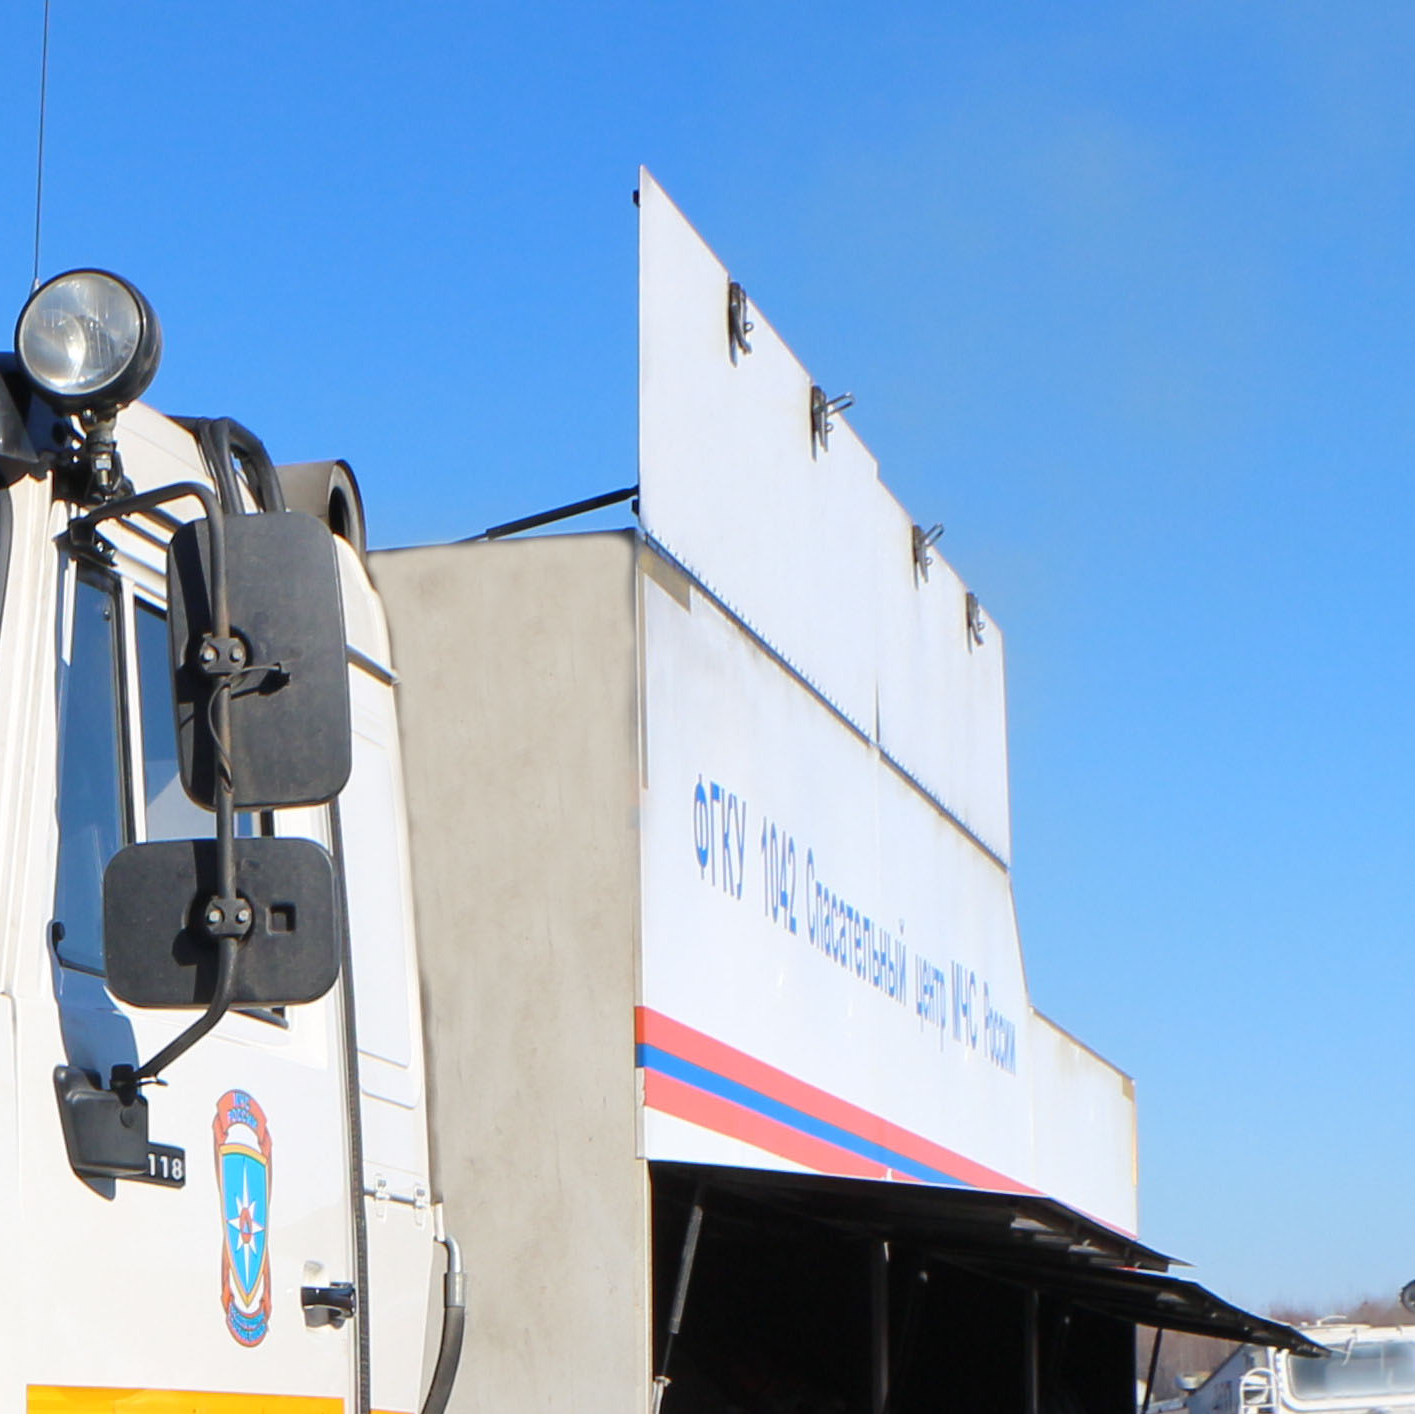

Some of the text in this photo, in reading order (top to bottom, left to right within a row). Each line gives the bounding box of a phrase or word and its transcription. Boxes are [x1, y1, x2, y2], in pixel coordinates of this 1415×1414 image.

[693, 773, 747, 901] ФГКУ
[761, 815, 798, 936] 1042
[805, 847, 908, 1008] Спасательный
[951, 960, 978, 1050] МЧС
[147, 1152, 183, 1181] 118
